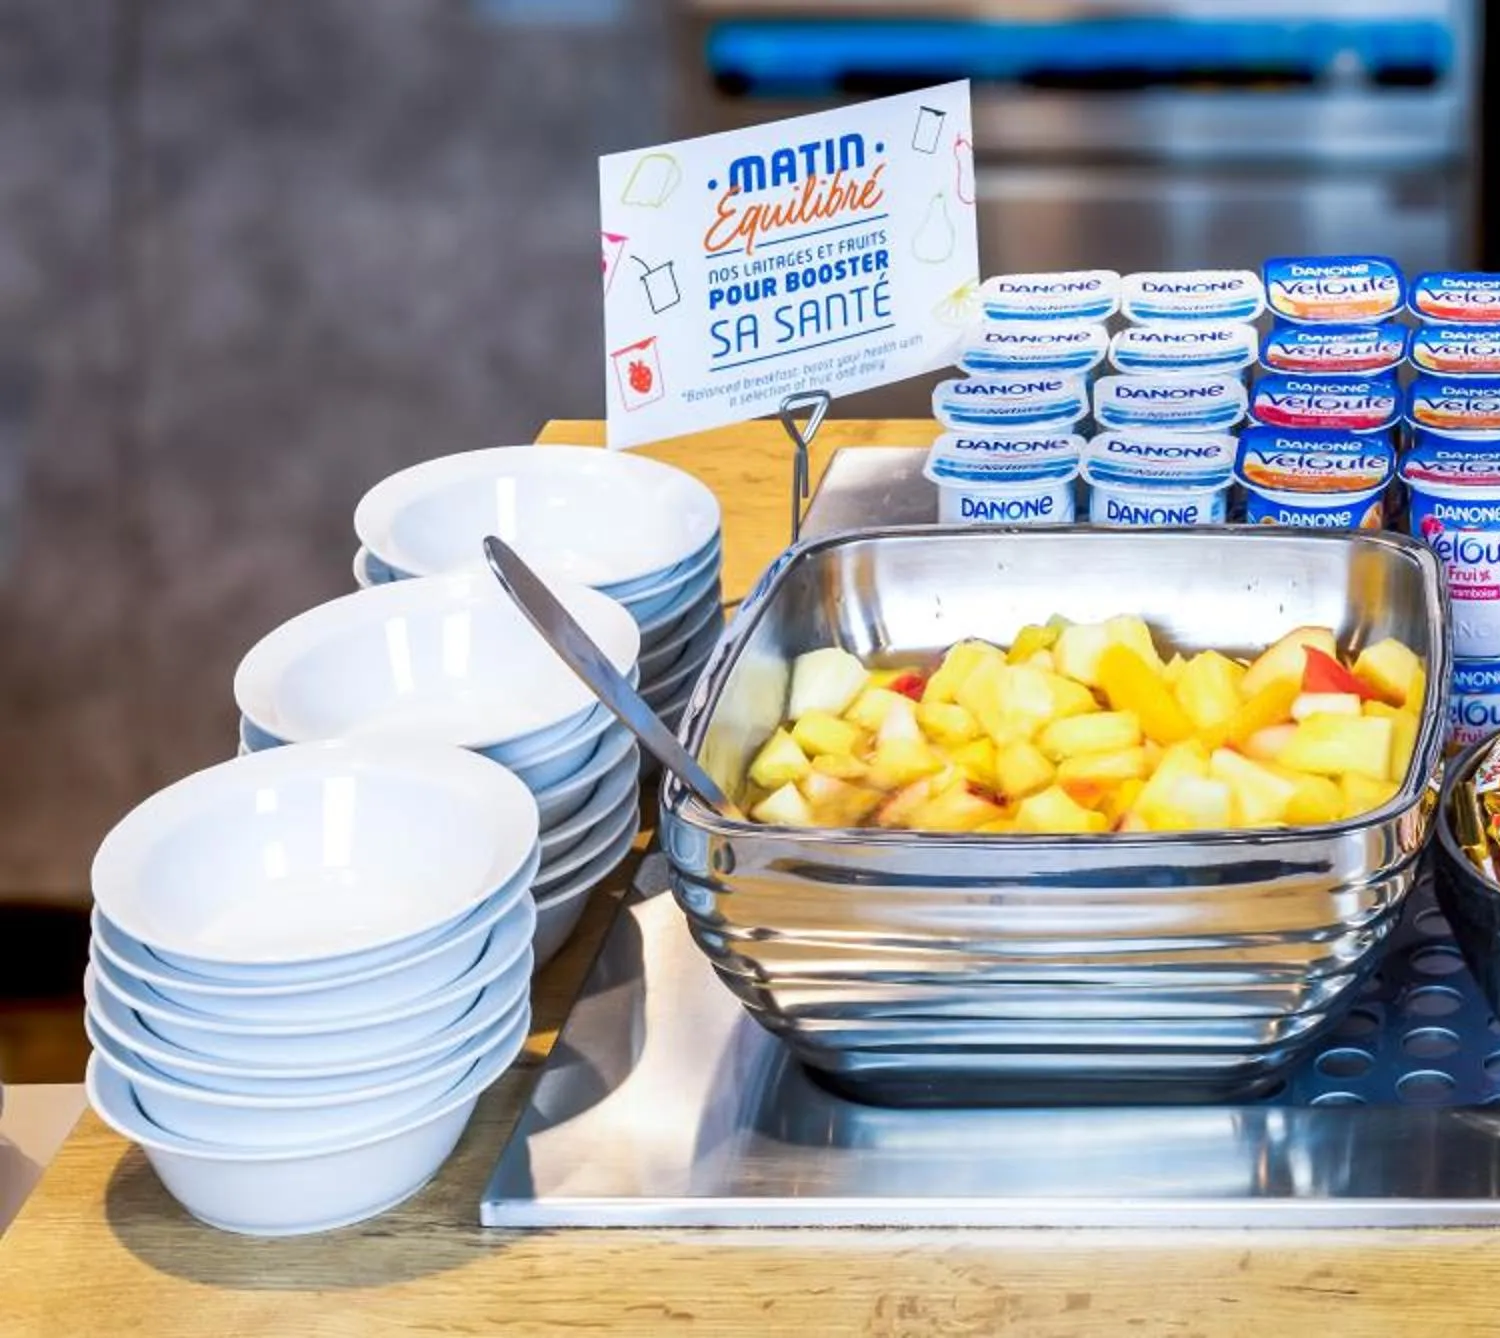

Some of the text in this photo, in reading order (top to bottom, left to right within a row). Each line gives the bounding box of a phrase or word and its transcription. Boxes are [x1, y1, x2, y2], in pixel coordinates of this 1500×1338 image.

[729, 133, 865, 195] MATIN
[708, 229, 887, 285] NOS LAITAGES ET FRUITS
[709, 250, 889, 310] POUR BOOSTER
[1000, 280, 1102, 293] DANONE
[1142, 280, 1244, 293] DANONE
[710, 271, 892, 358] SA SANTÉ
[985, 331, 1091, 343] DANONE
[1129, 331, 1233, 343] DANONE
[954, 381, 1063, 395] DANONE
[1115, 385, 1225, 399] DANONE
[955, 439, 1070, 452] DANONE
[1107, 441, 1222, 458] DANONE
[961, 495, 1053, 520] DANONE
[1107, 500, 1199, 525] DANONE
[1279, 510, 1353, 527] DANONE
